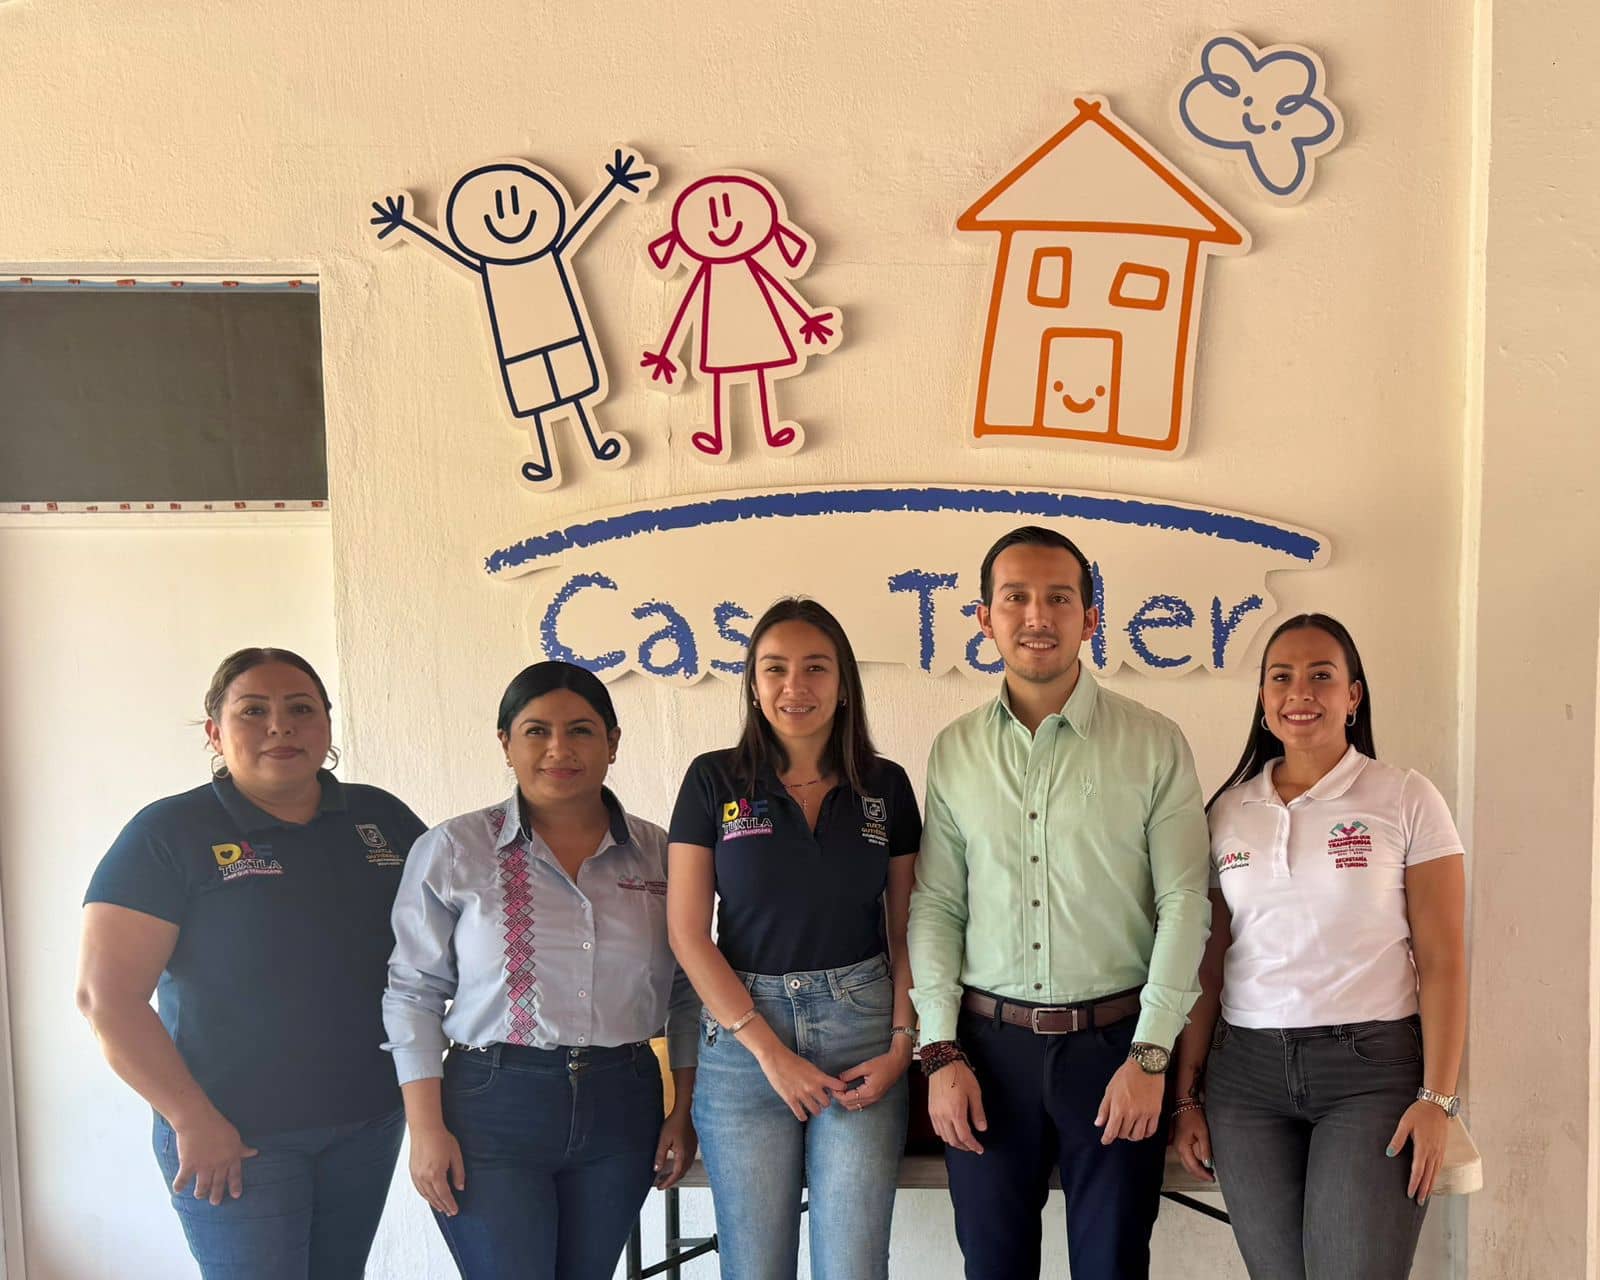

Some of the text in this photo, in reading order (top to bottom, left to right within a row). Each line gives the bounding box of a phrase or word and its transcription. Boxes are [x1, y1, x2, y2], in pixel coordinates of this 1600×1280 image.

[540, 561, 1263, 679] Cas Tler
[722, 817, 774, 835] TUXTLA
[1328, 839, 1372, 849] TRANSFORMA
[218, 858, 283, 877] TUXTLA
[1335, 855, 1368, 864] SECRETARÍA
